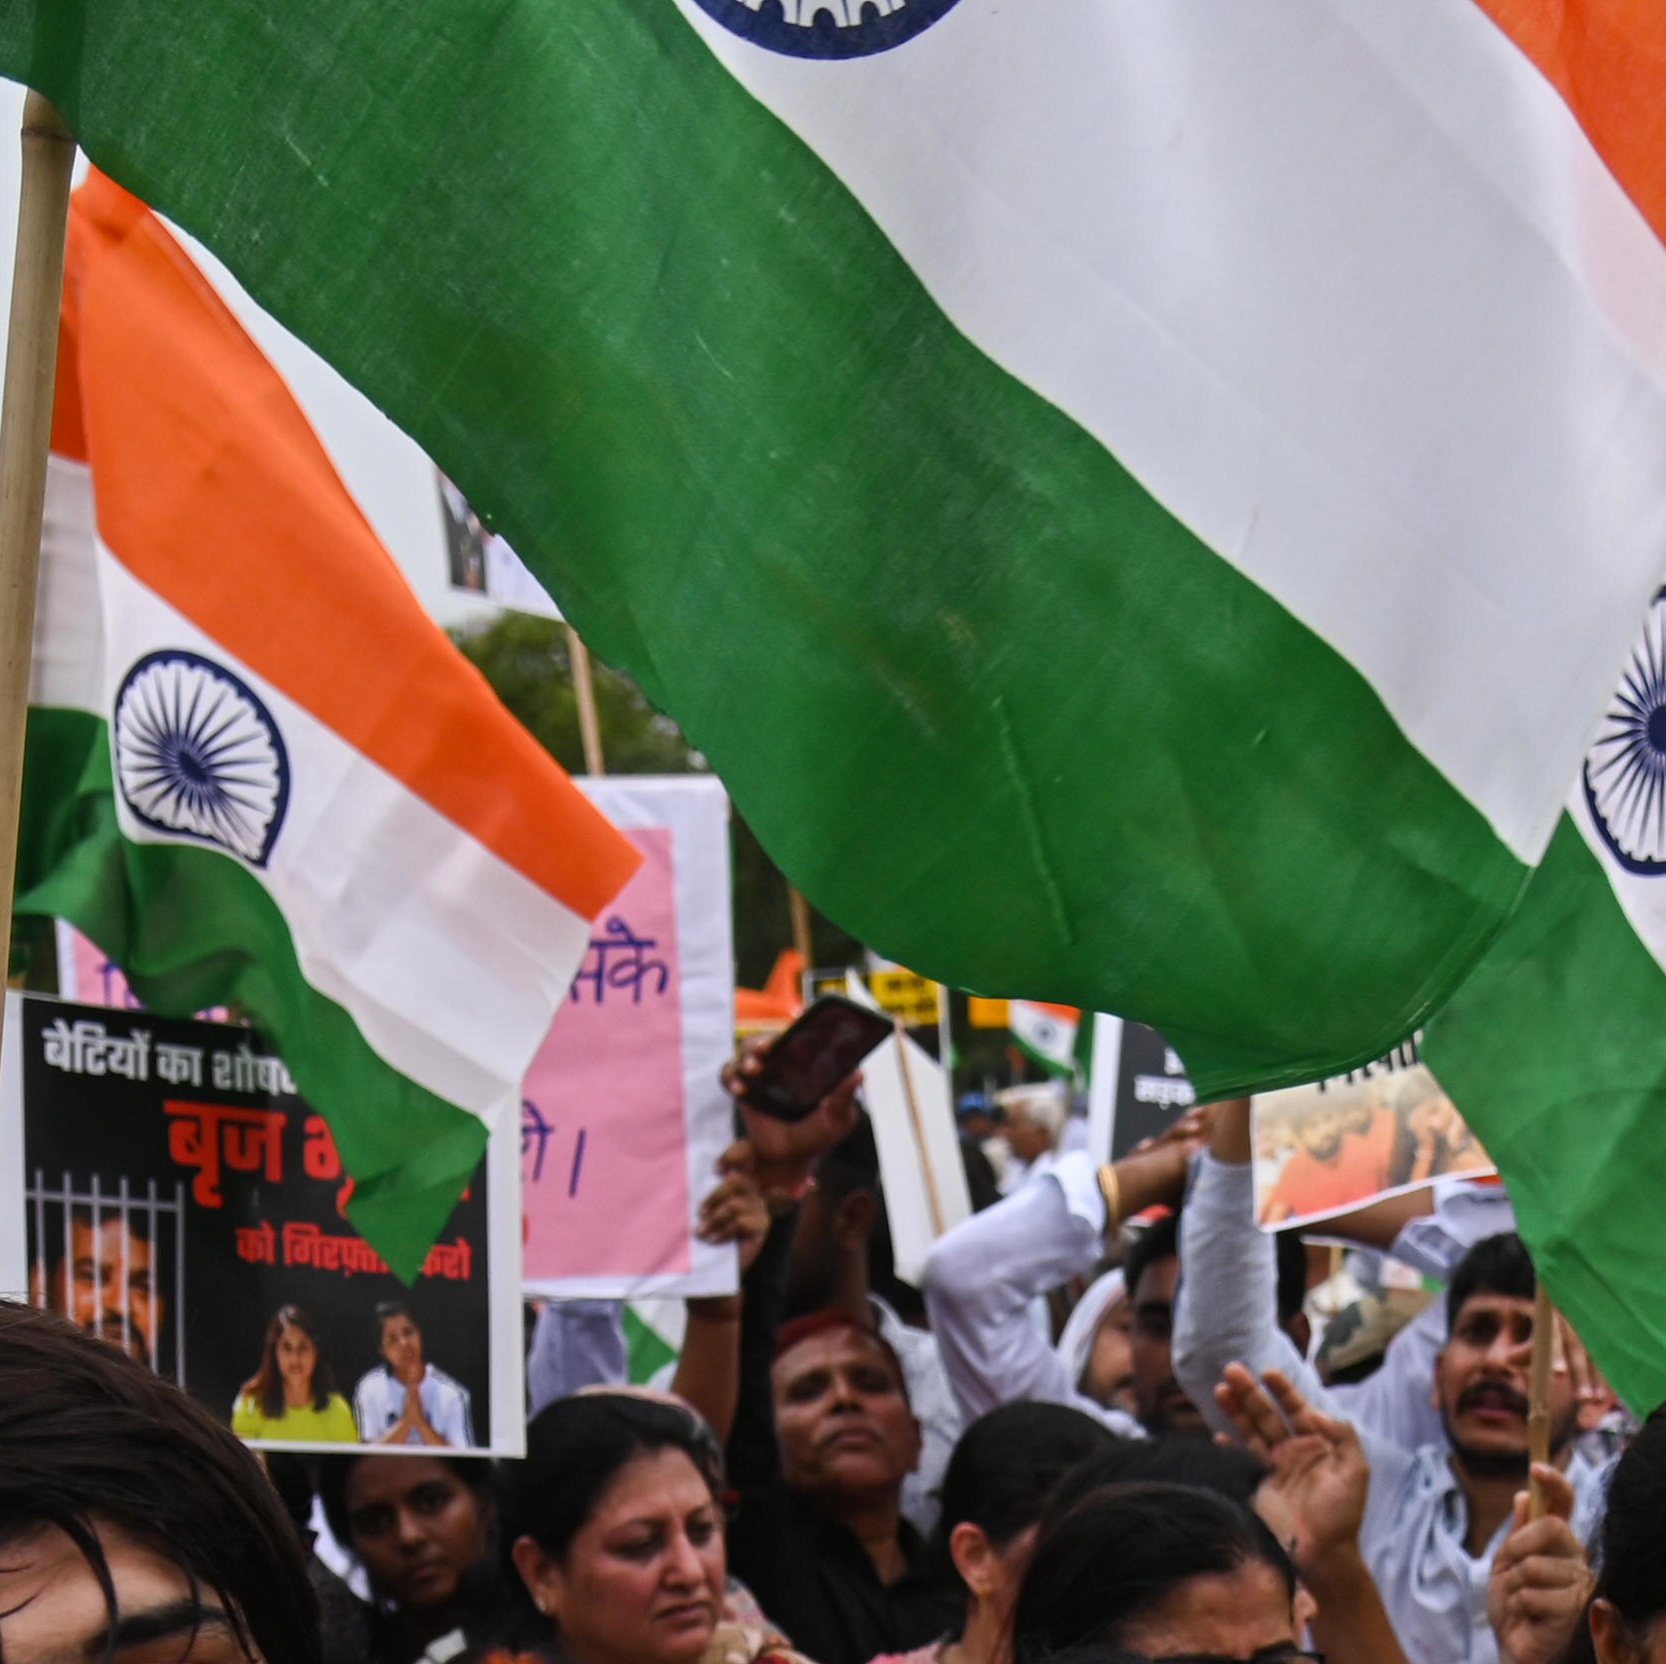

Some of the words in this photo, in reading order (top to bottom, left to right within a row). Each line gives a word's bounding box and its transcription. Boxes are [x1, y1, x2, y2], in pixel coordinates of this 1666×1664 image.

[41, 1017, 152, 1082] बेटियों
[155, 1042, 205, 1088] का
[162, 1099, 288, 1208] बृज
[235, 1219, 277, 1266] को
